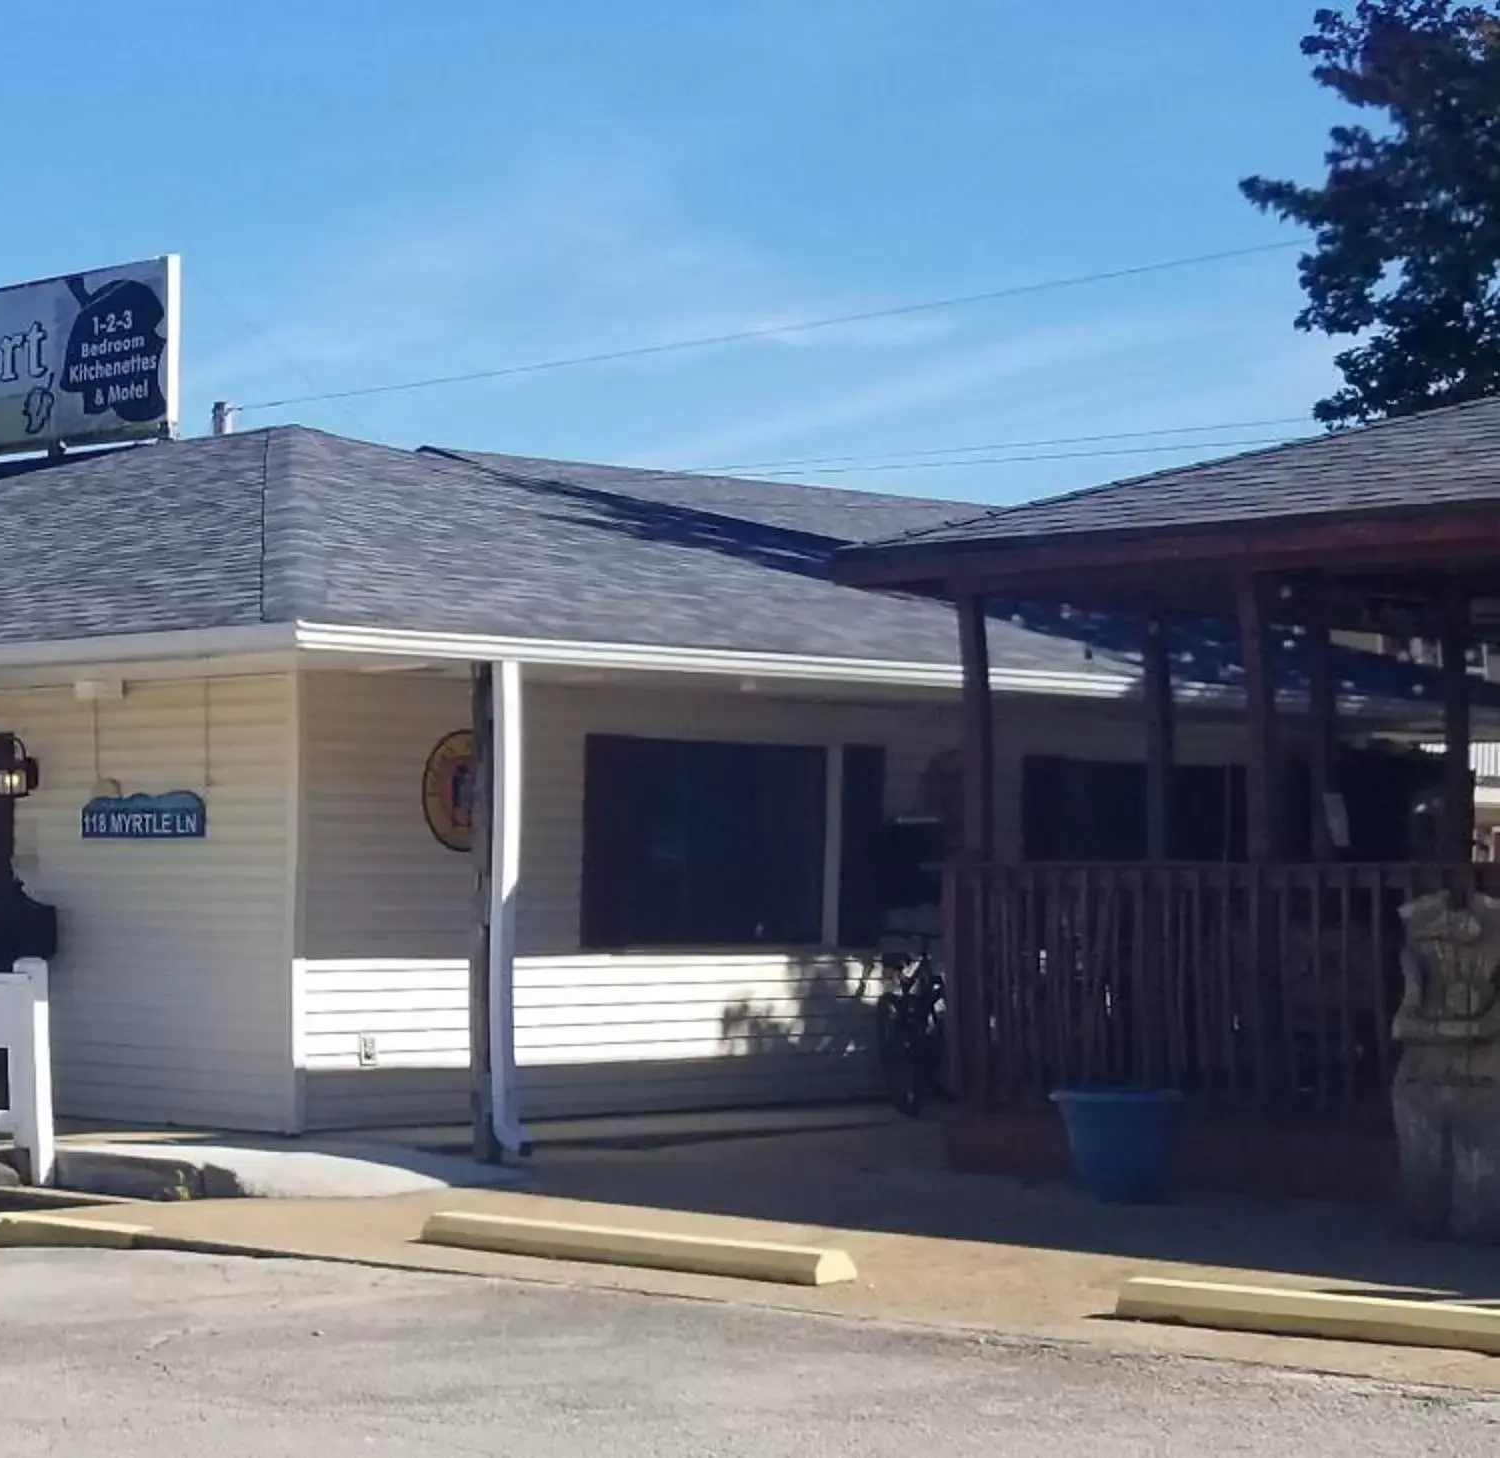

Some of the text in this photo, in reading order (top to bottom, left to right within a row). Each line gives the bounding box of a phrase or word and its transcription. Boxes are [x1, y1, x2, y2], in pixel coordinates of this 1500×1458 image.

[92, 309, 133, 336] 1-2-3
[81, 335, 145, 358] Bedroom
[69, 355, 158, 384] Kitchenettes
[94, 378, 149, 406] & Motel
[83, 812, 197, 833] 118 MYRTLE LN
